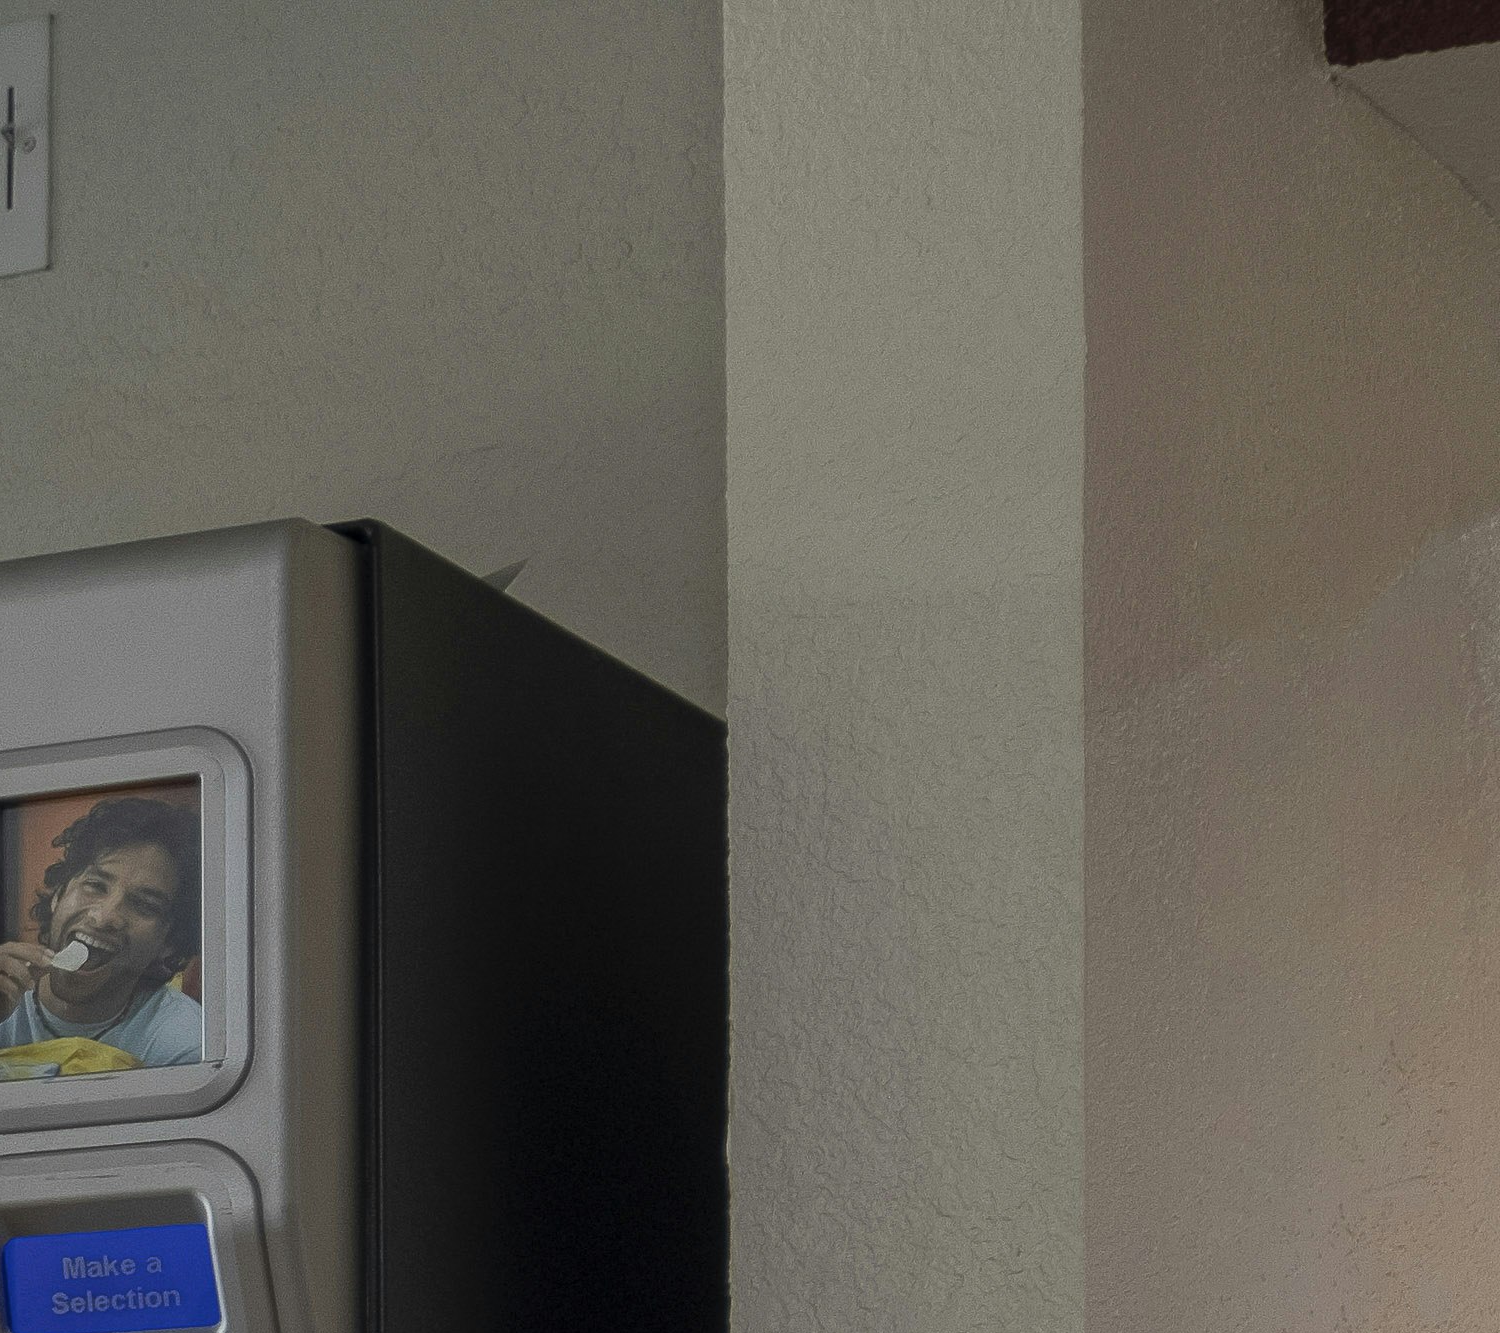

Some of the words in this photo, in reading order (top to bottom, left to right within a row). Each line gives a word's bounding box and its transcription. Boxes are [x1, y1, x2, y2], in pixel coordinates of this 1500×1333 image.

[62, 1256, 137, 1280] Make
[146, 1256, 163, 1275] a
[51, 1287, 181, 1315] Selection
